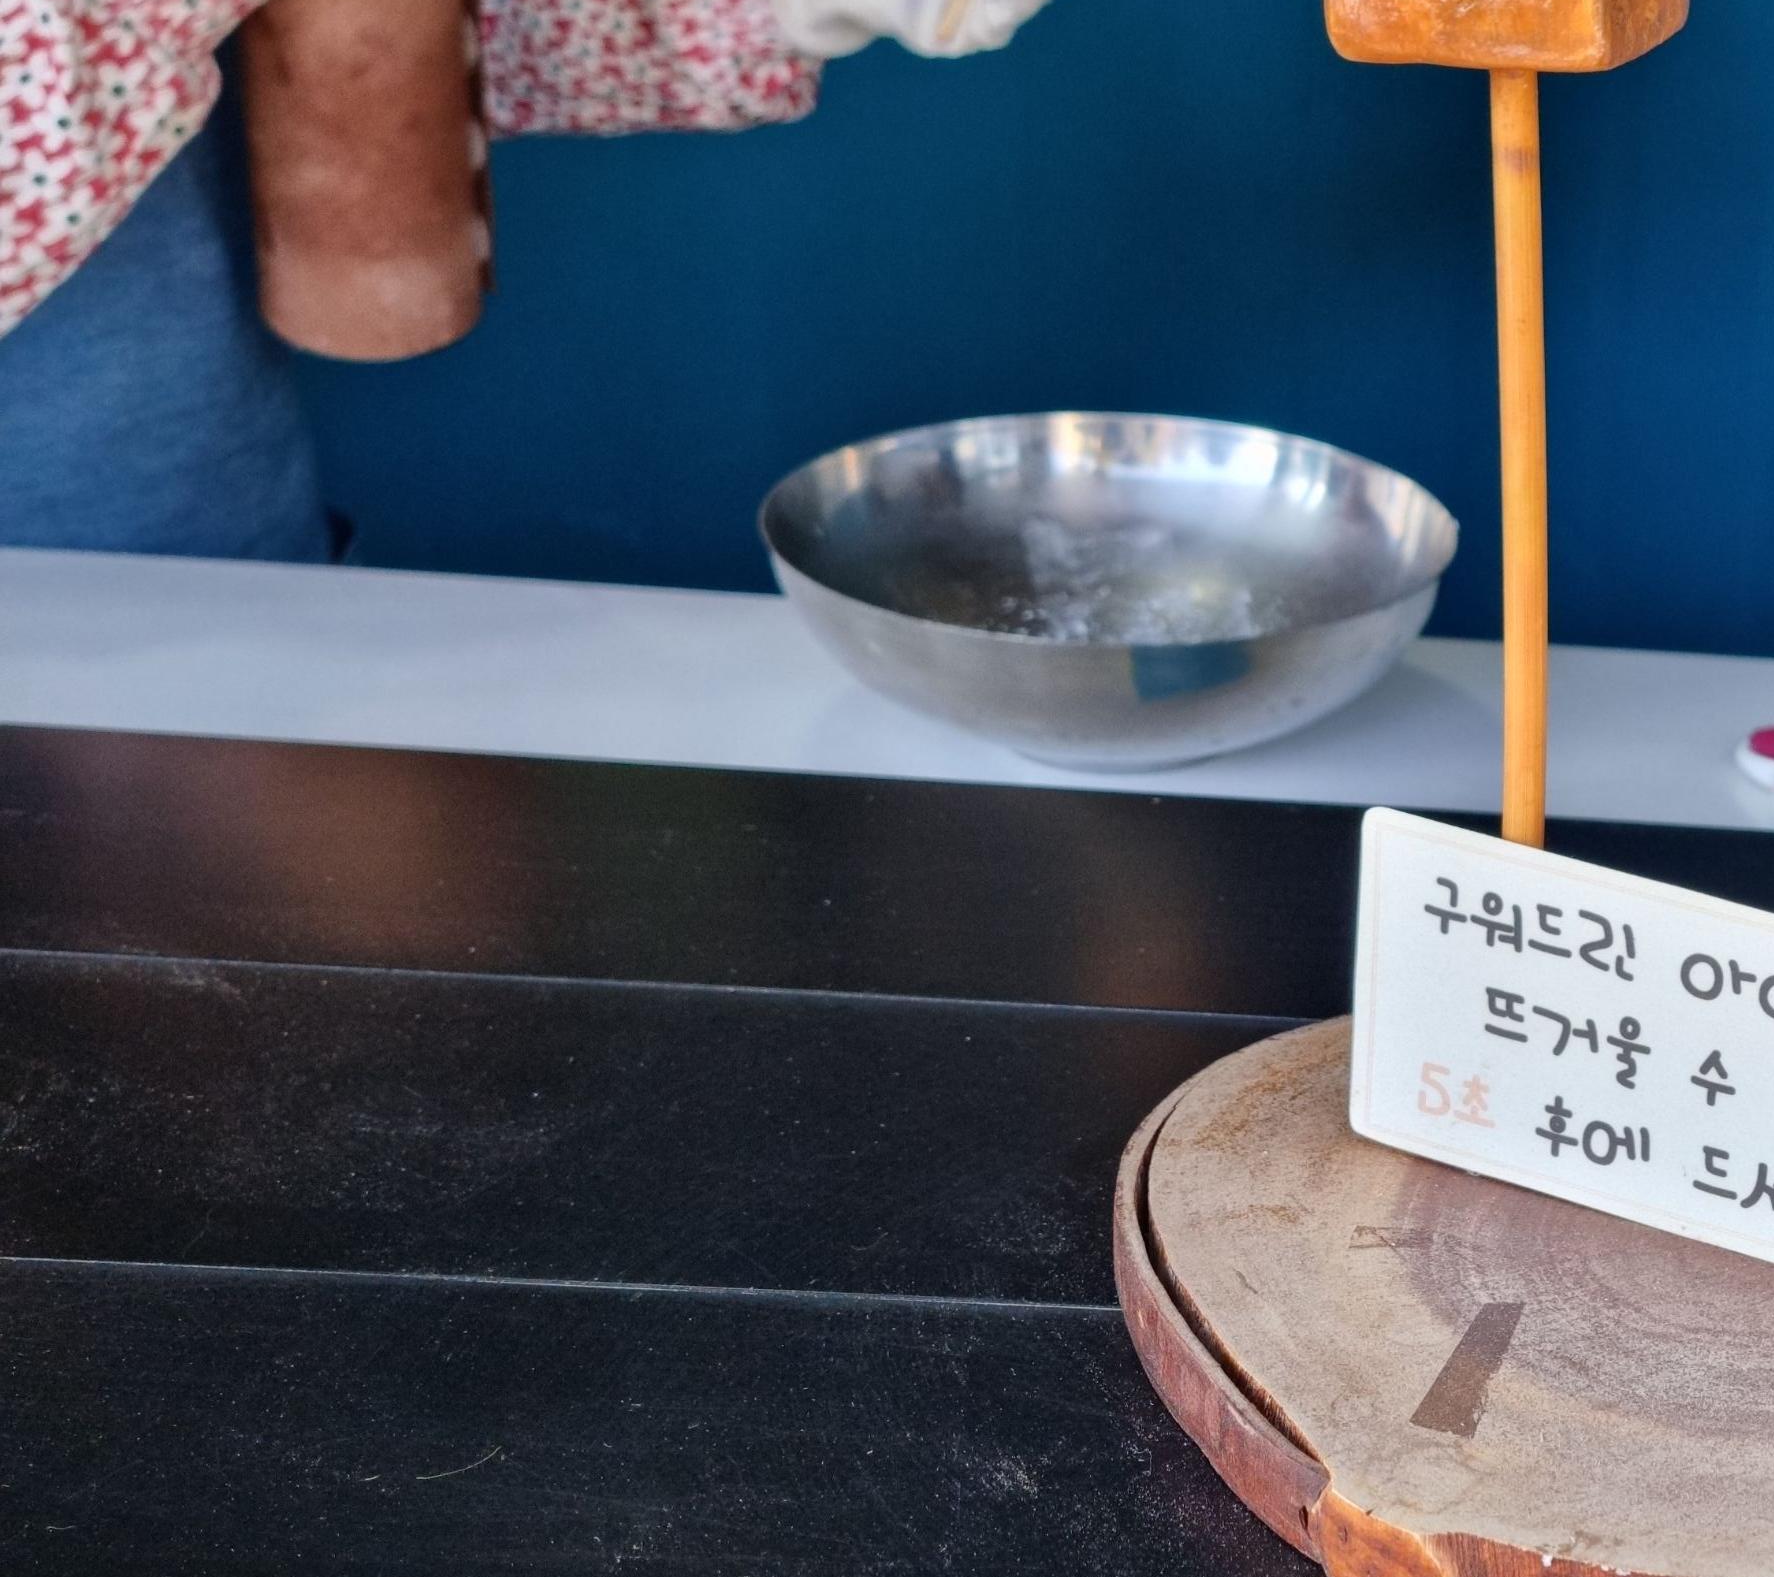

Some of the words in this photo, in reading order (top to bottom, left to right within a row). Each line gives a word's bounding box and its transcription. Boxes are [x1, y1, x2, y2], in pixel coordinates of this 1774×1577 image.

[1423, 876, 1637, 982] 구워드린
[1484, 986, 1652, 1089] 뜨거울
[1690, 1049, 1736, 1107] 수
[1416, 1062, 1497, 1129] 5초
[1535, 1096, 1651, 1166] 후에
